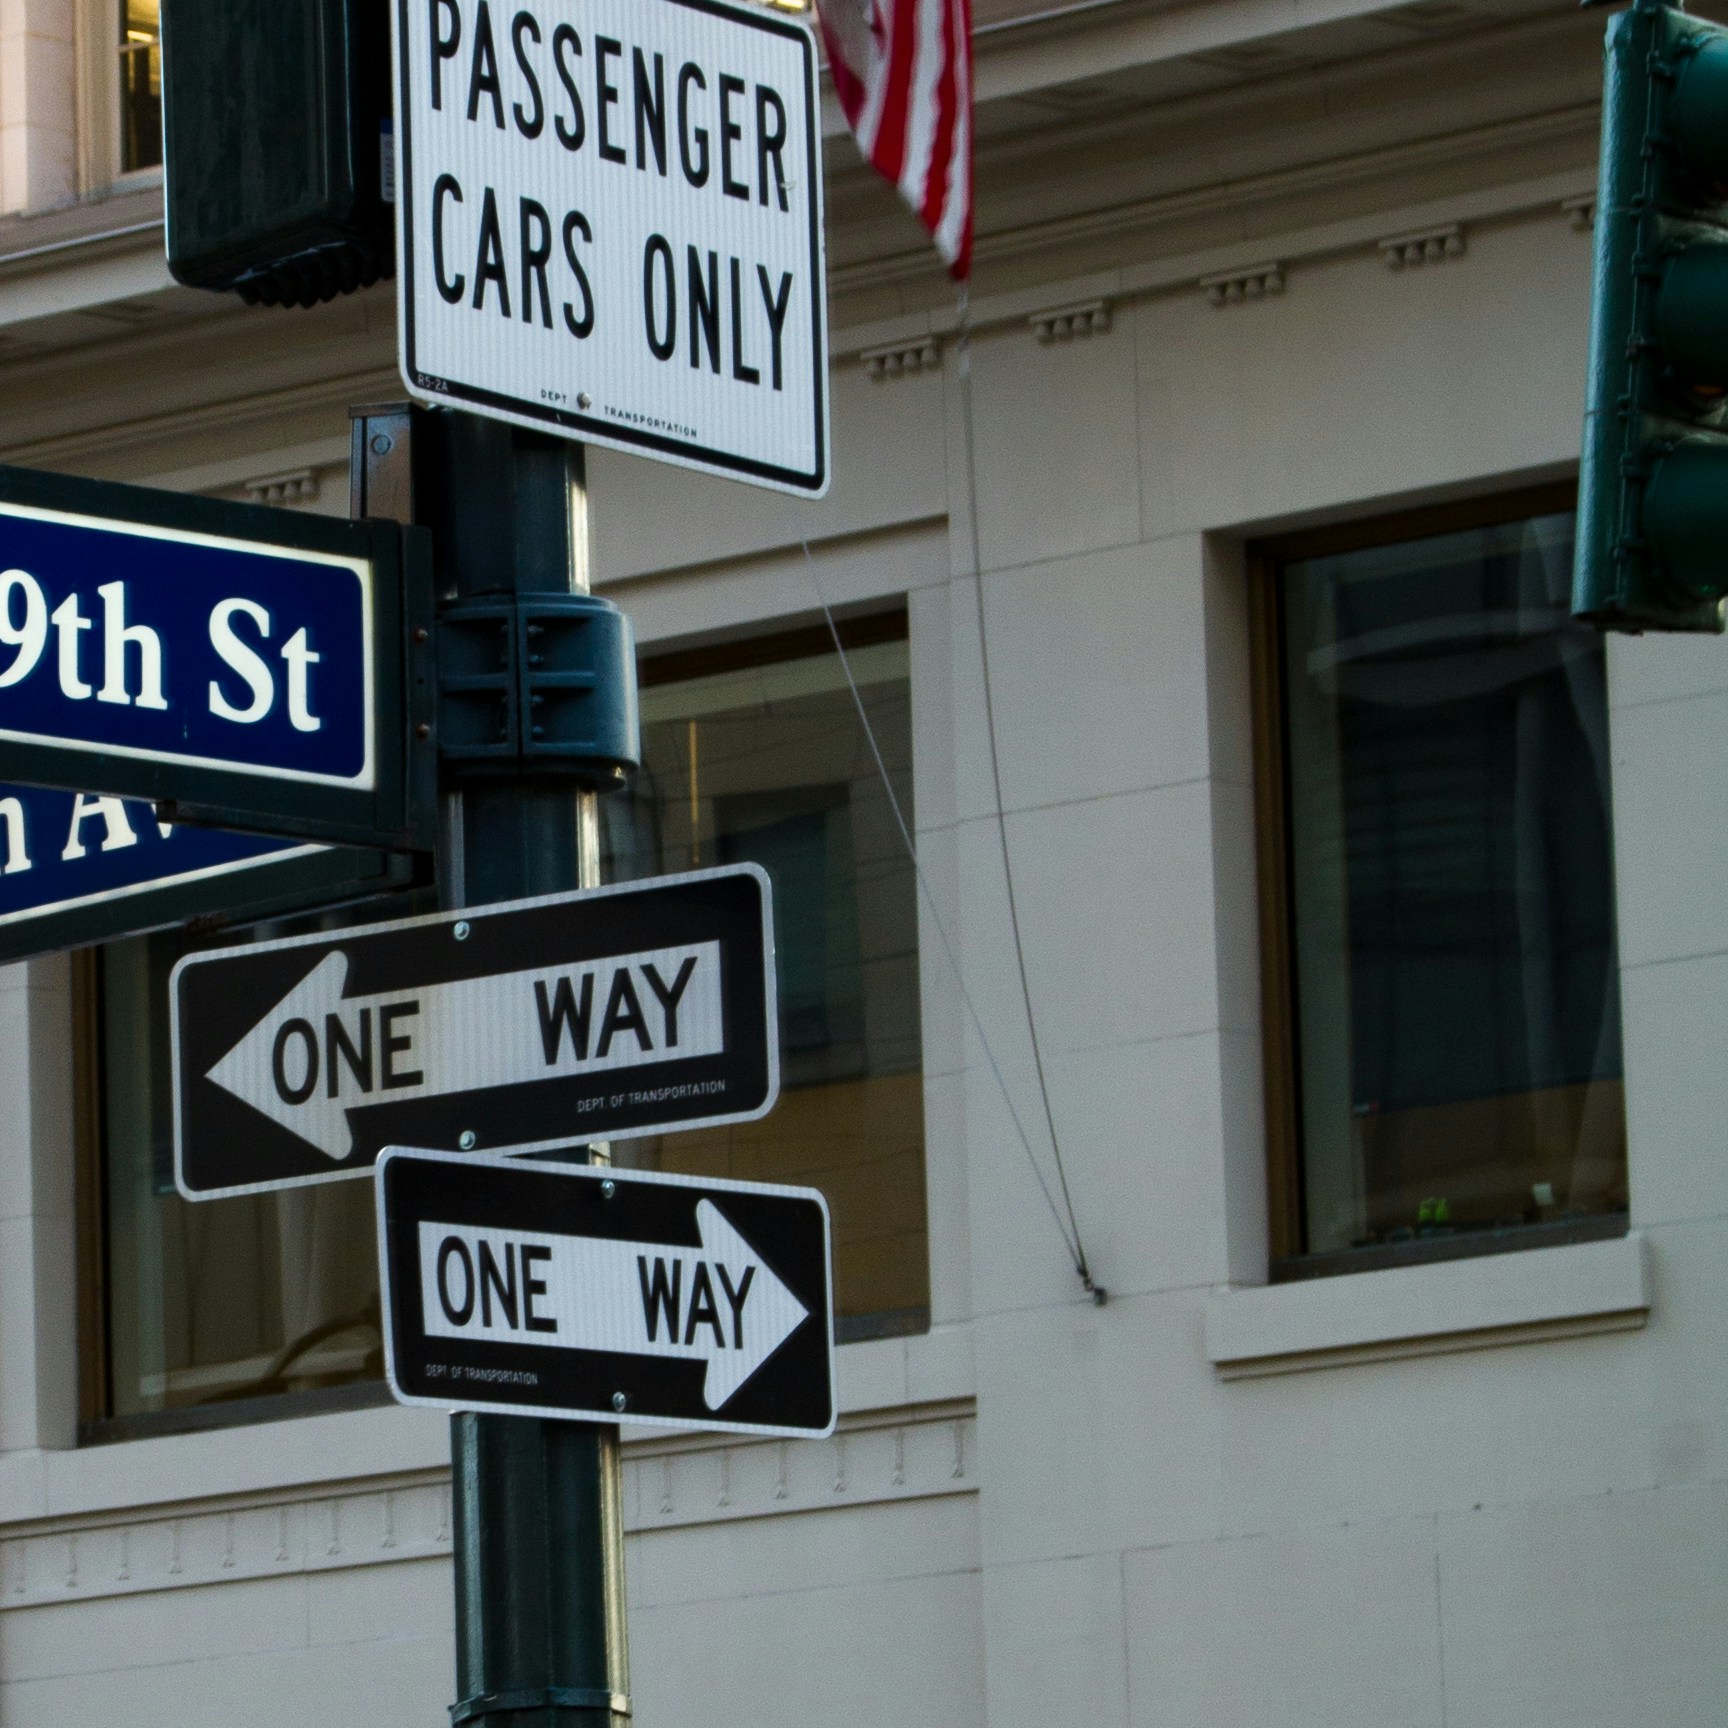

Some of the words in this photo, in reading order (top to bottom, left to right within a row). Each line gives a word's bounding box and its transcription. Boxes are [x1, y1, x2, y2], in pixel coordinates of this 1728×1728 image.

[432, 173, 595, 340] CARS
[643, 233, 793, 392] ONLY
[540, 389, 567, 404] DEPT
[604, 405, 698, 438] TRANSPORTATION
[209, 598, 321, 732] St
[272, 1000, 424, 1106] ONE
[533, 956, 698, 1067] WAY
[610, 1094, 625, 1108] OF
[628, 1079, 726, 1105] TRANSPORTATION
[436, 1235, 558, 1334] ONE
[637, 1254, 756, 1350] WAY
[451, 1366, 462, 1379] OF
[465, 1367, 538, 1385] TRANSPORTATION
